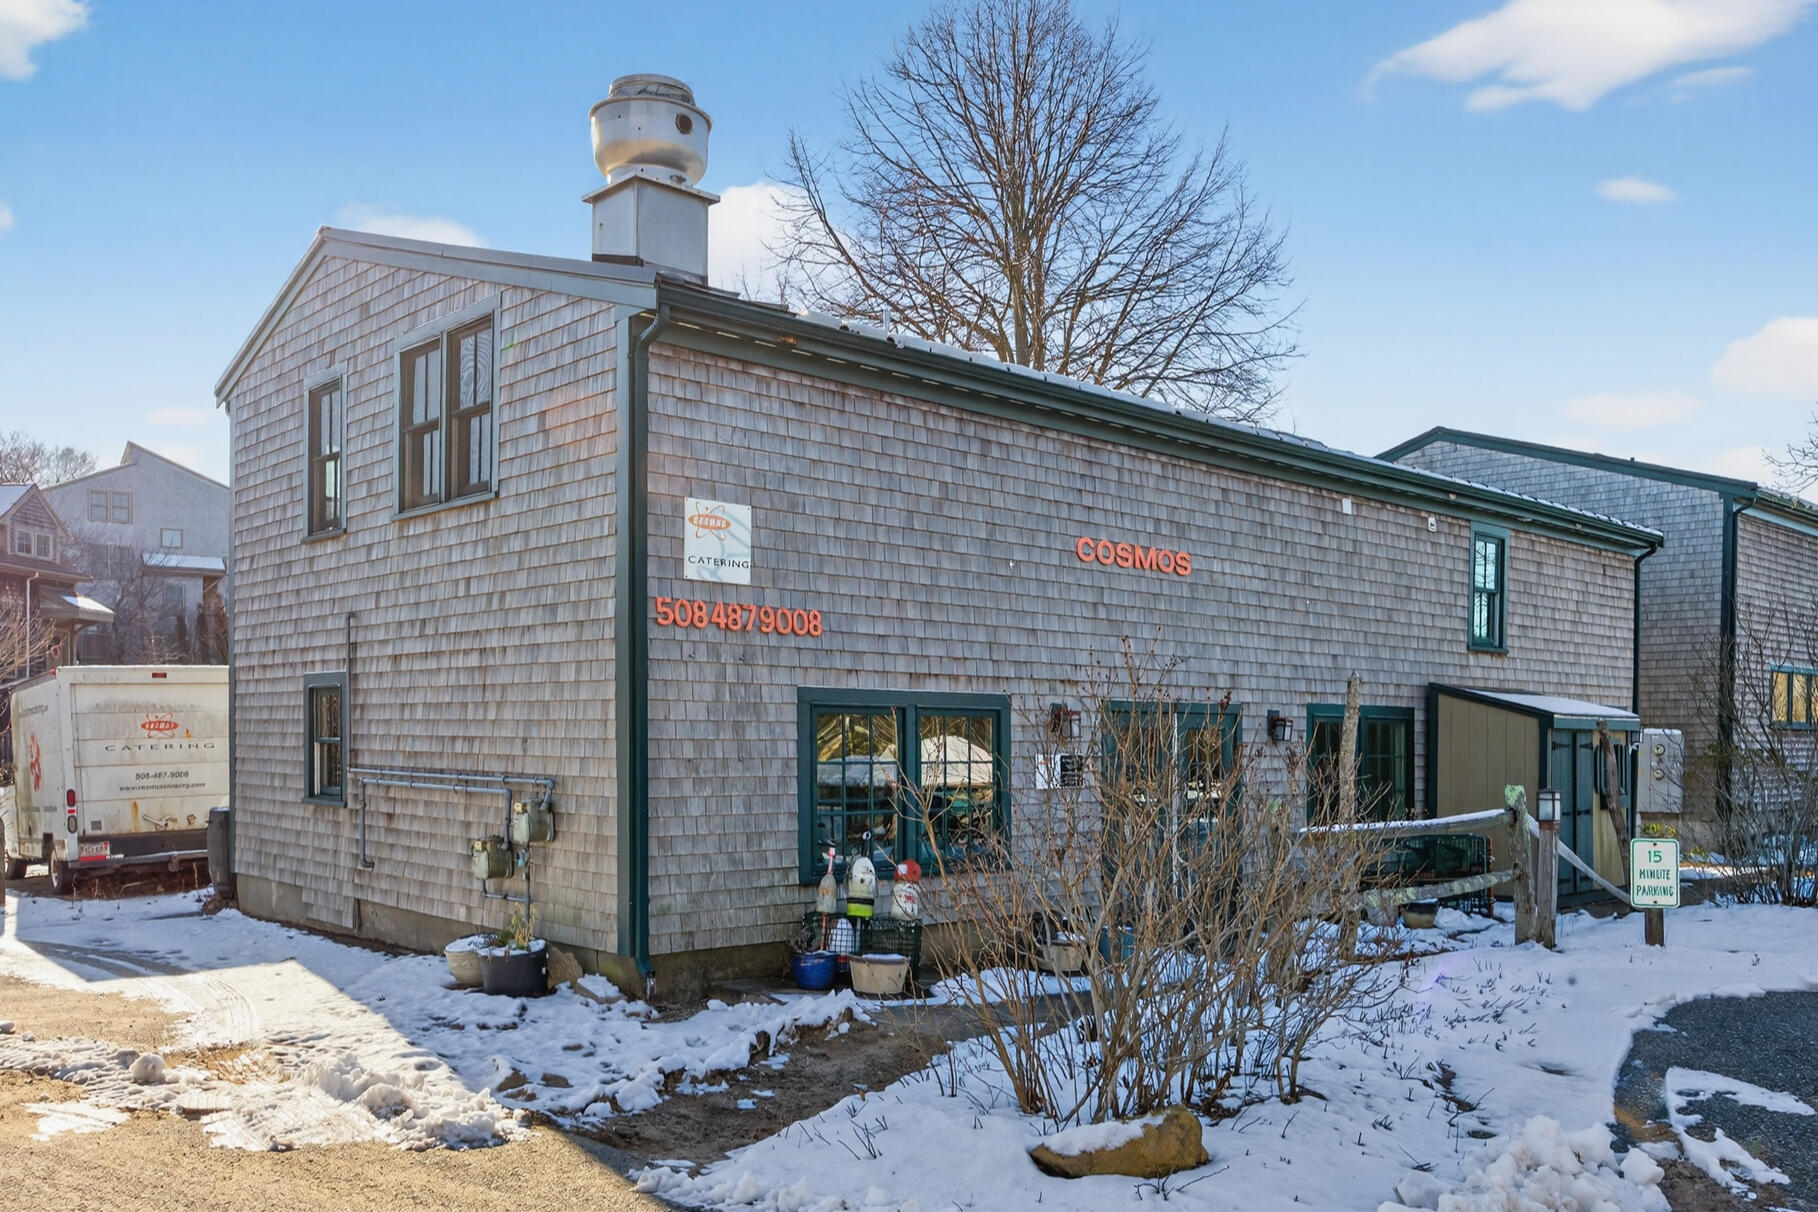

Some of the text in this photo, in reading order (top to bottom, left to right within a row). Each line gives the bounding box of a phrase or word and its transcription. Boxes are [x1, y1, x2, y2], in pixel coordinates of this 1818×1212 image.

[688, 555, 749, 569] CATERING
[1076, 535, 1192, 576] COSMOS
[105, 742, 215, 752] CATERING
[1648, 850, 1662, 863] 15
[1639, 868, 1671, 880] MINUTE
[1636, 884, 1674, 897] PARKING
